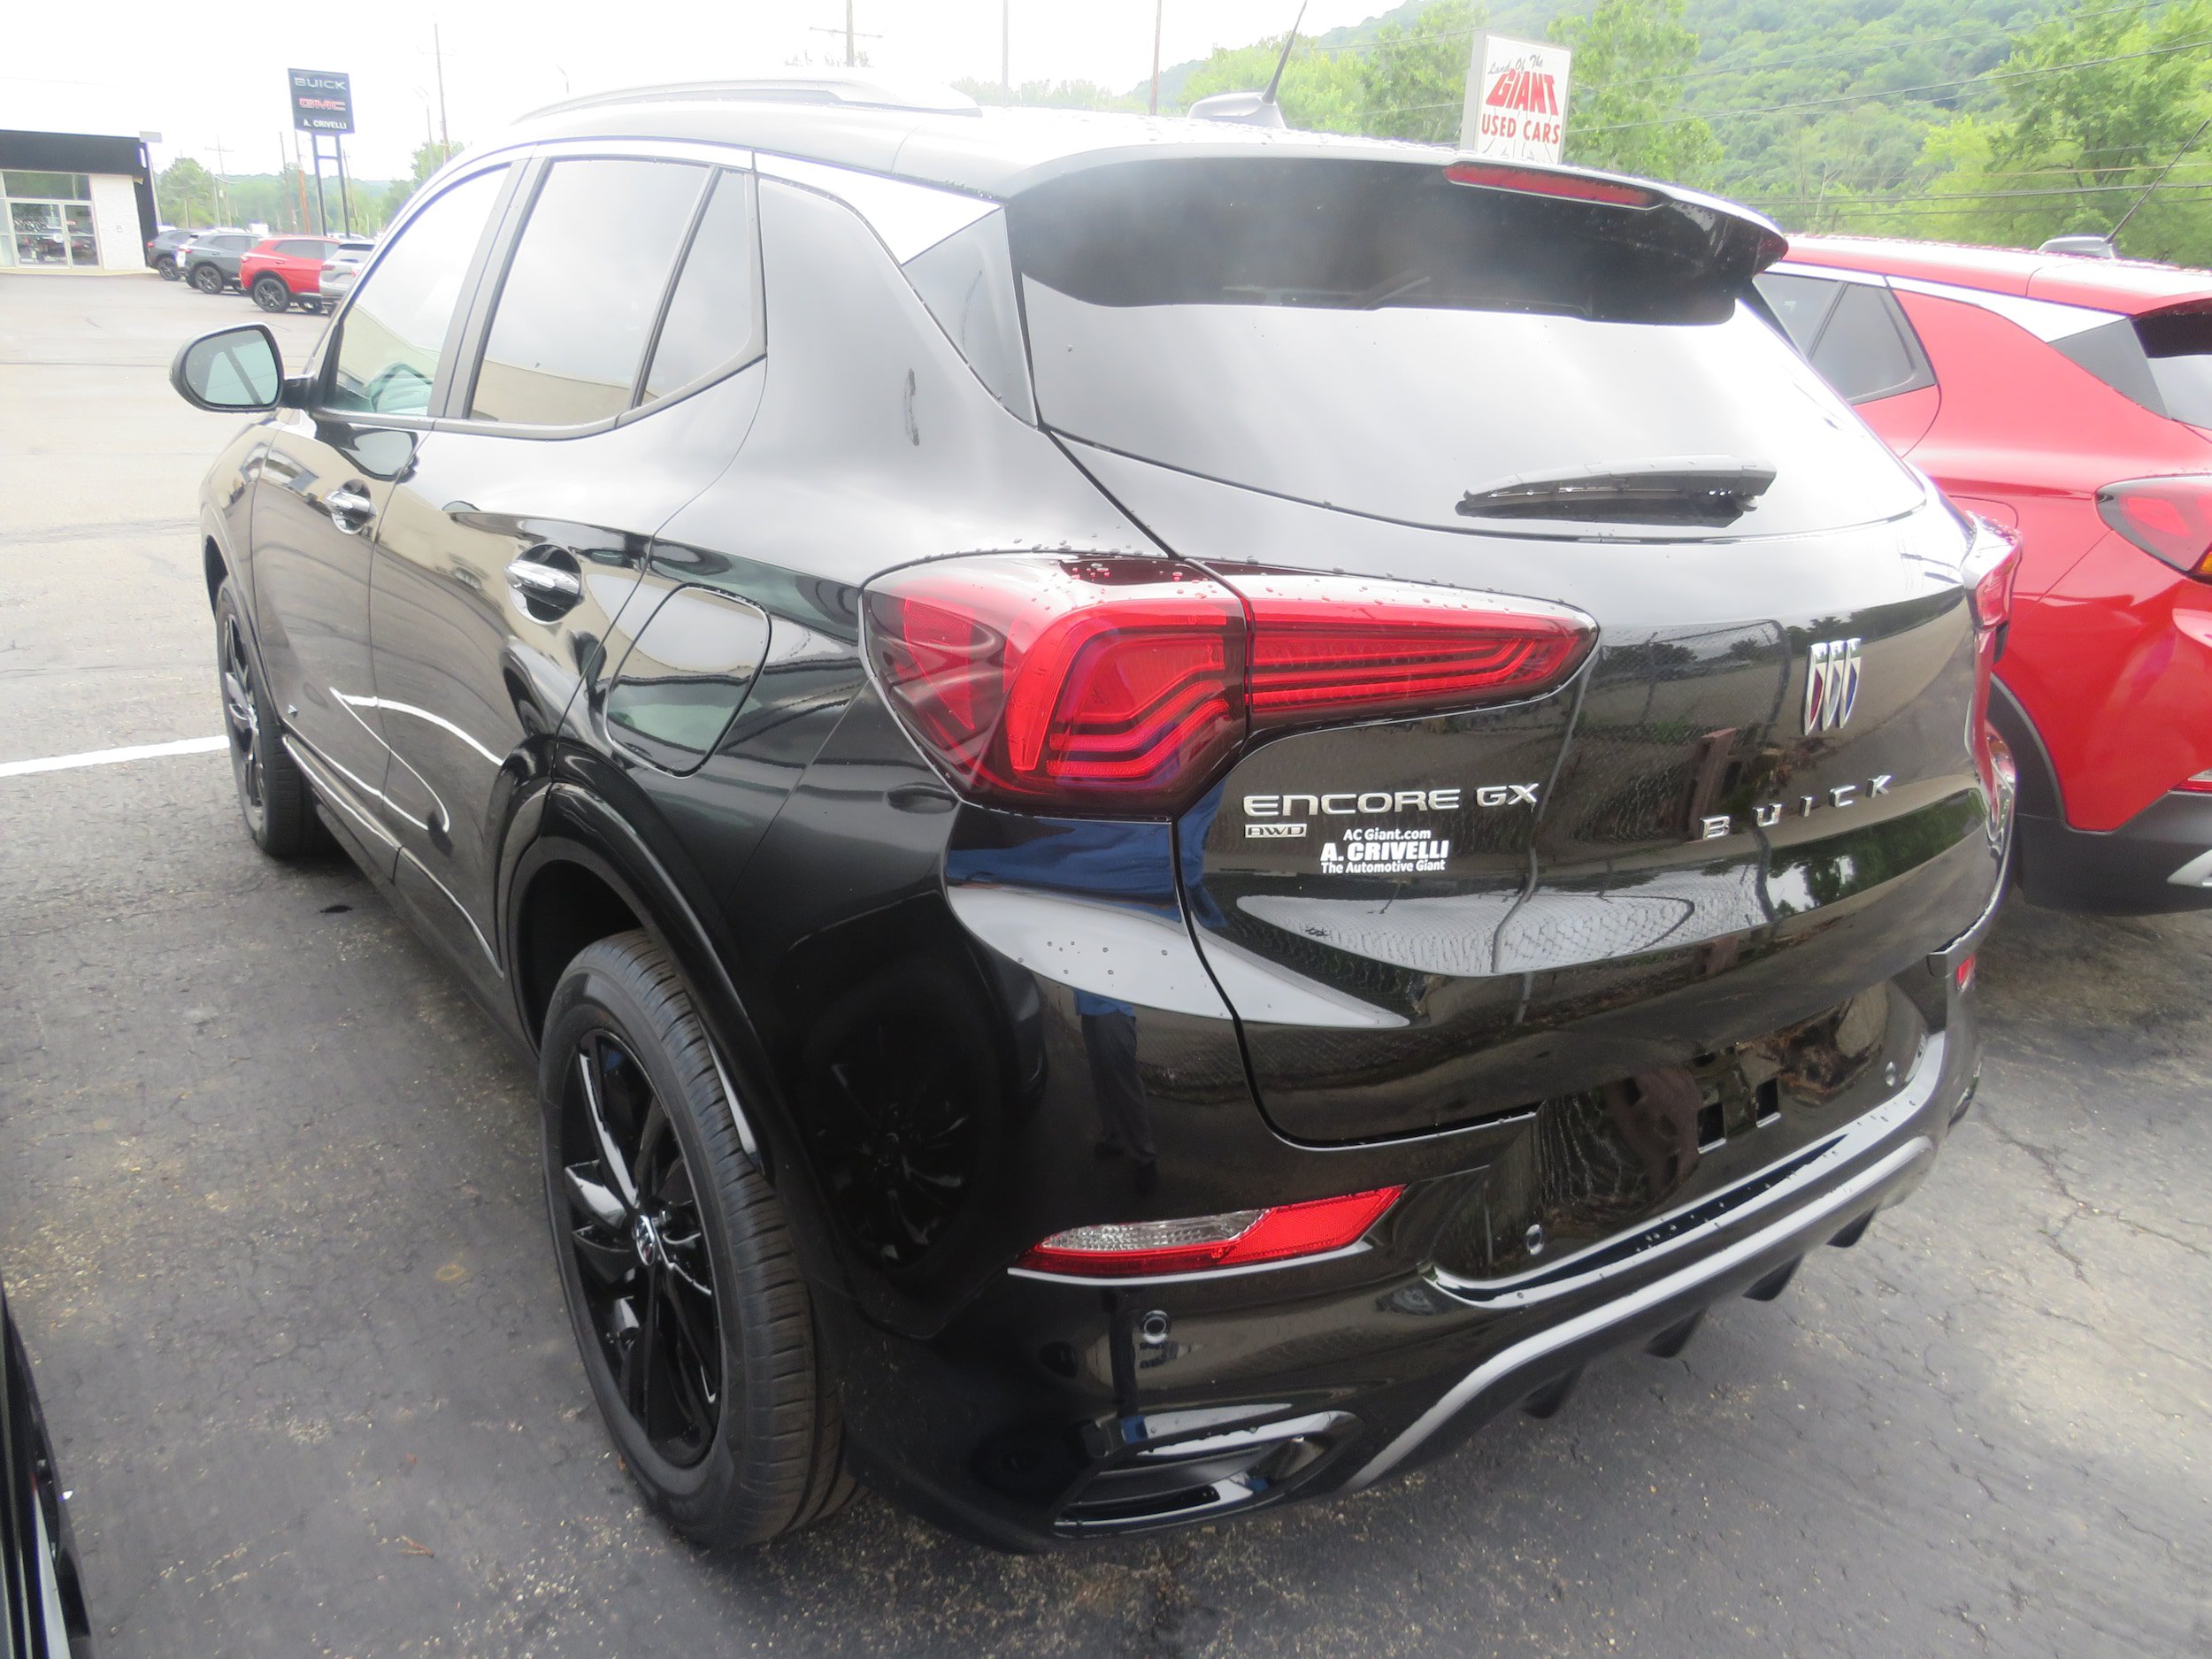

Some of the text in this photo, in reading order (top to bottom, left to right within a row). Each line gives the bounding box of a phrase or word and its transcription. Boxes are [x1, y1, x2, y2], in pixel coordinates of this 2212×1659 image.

[1529, 54, 1544, 69] The
[295, 78, 346, 90] BUICK
[1486, 68, 1559, 116] GIANT
[299, 98, 346, 111] GMC
[303, 119, 347, 129] A. CRIVELLI
[1481, 113, 1560, 144] USED CARS
[1243, 783, 1539, 817] ENCORE GX
[1700, 774, 1892, 840] BUICK
[1247, 826, 1305, 836] AWD
[1343, 827, 1432, 841] AC Giant.com
[1320, 840, 1449, 862] A. CRIVELLI
[1321, 859, 1446, 874] The Automotive Giant
